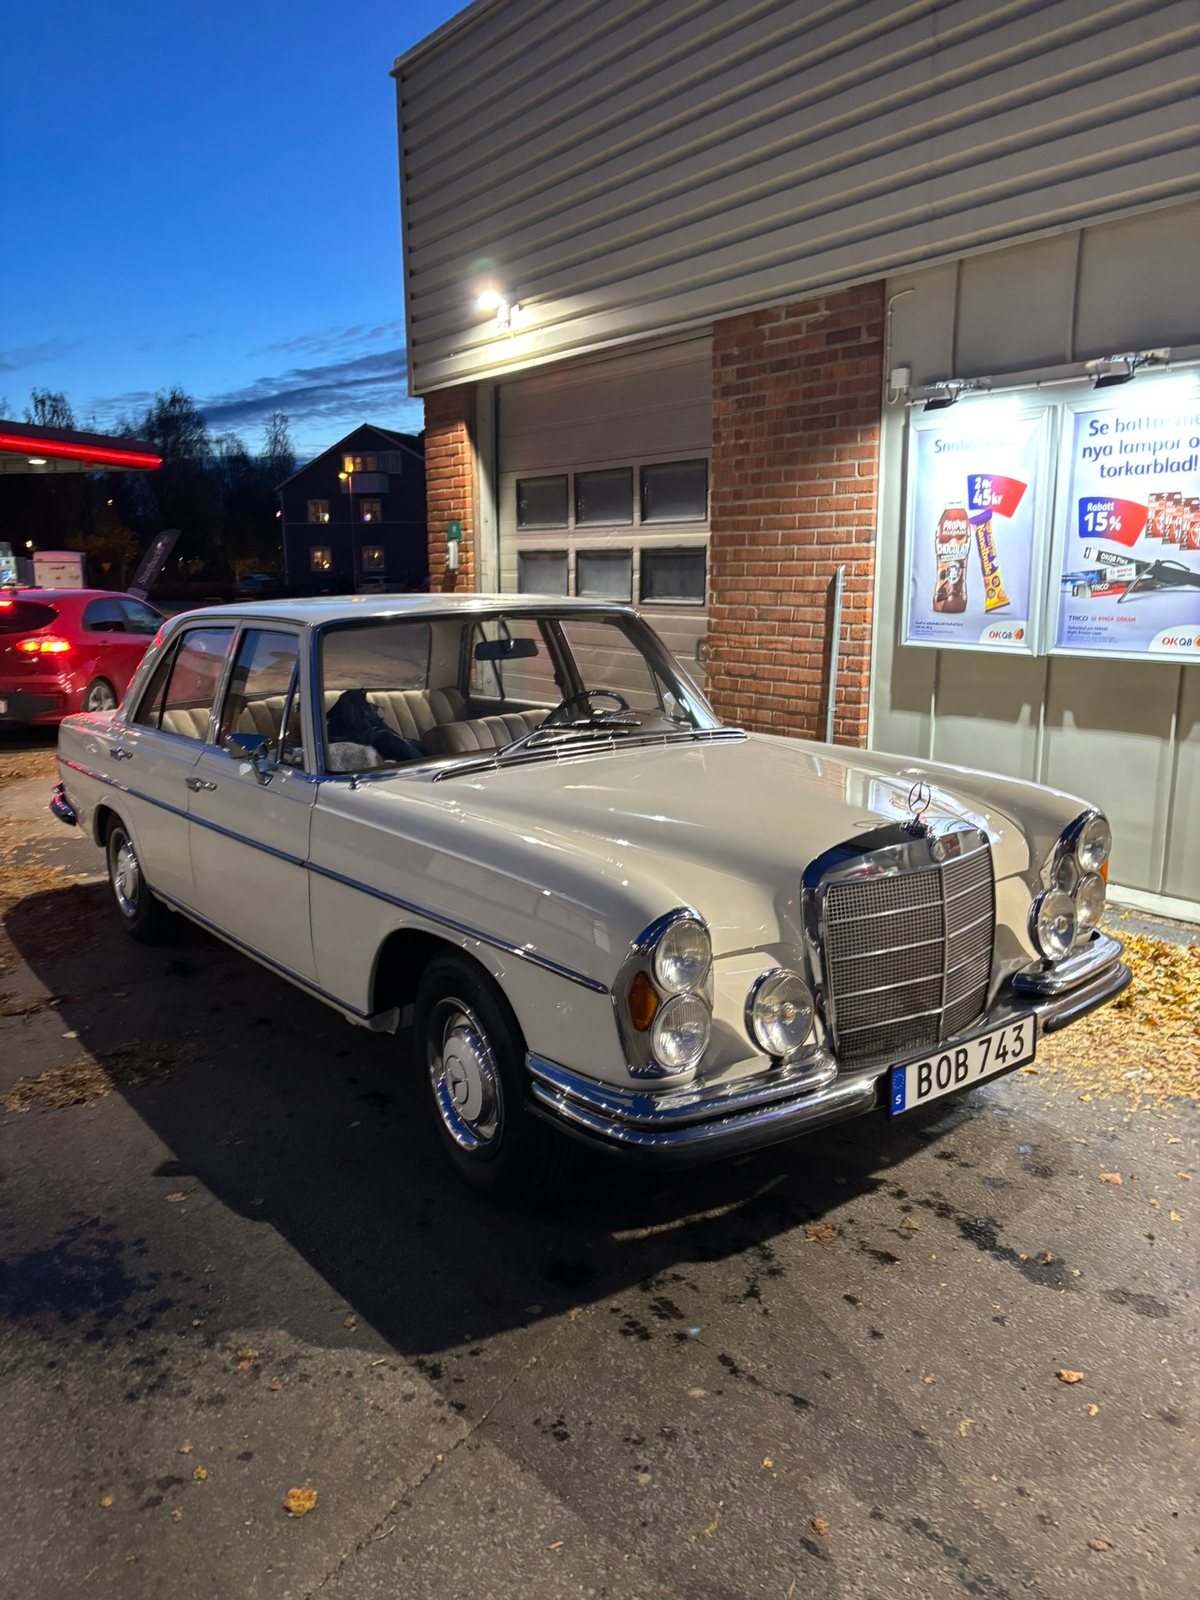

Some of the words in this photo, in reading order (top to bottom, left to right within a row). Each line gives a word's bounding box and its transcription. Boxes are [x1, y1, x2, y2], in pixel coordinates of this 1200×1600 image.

[1088, 419, 1110, 437] Se
[1082, 445, 1113, 462] nya
[1119, 438, 1183, 456] lampor
[1100, 454, 1199, 479] torkarblad!
[974, 476, 982, 490] 2
[1087, 501, 1115, 512] Rabatt
[1084, 511, 1122, 532] 15%
[917, 1047, 969, 1099] BOB
[978, 1023, 1025, 1075] 743
[895, 1094, 902, 1105] S
